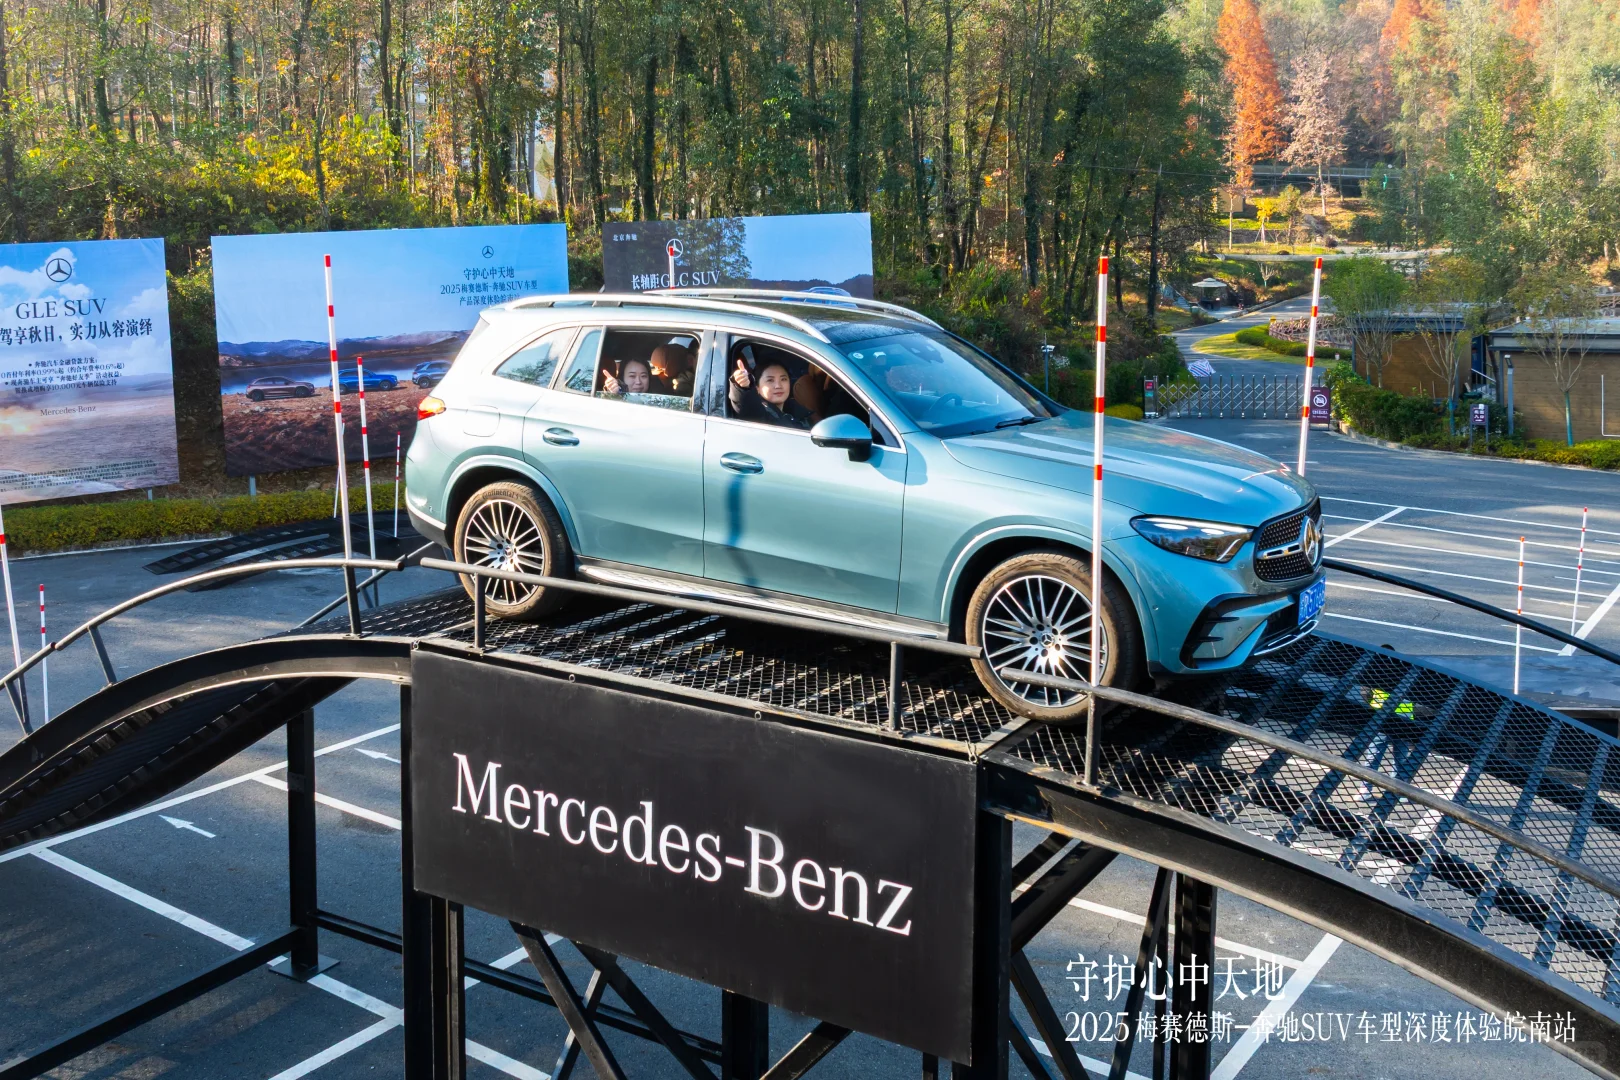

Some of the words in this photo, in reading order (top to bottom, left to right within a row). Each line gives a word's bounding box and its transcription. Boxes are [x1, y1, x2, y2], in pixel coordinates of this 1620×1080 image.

[463, 266, 515, 280] 守护心中天地
[692, 270, 721, 286] SUV
[15, 300, 58, 320] GLE
[64, 298, 107, 317] SUV
[40, 405, 97, 417] Mercedes-Benz
[452, 752, 913, 936] Mercedes-Benz
